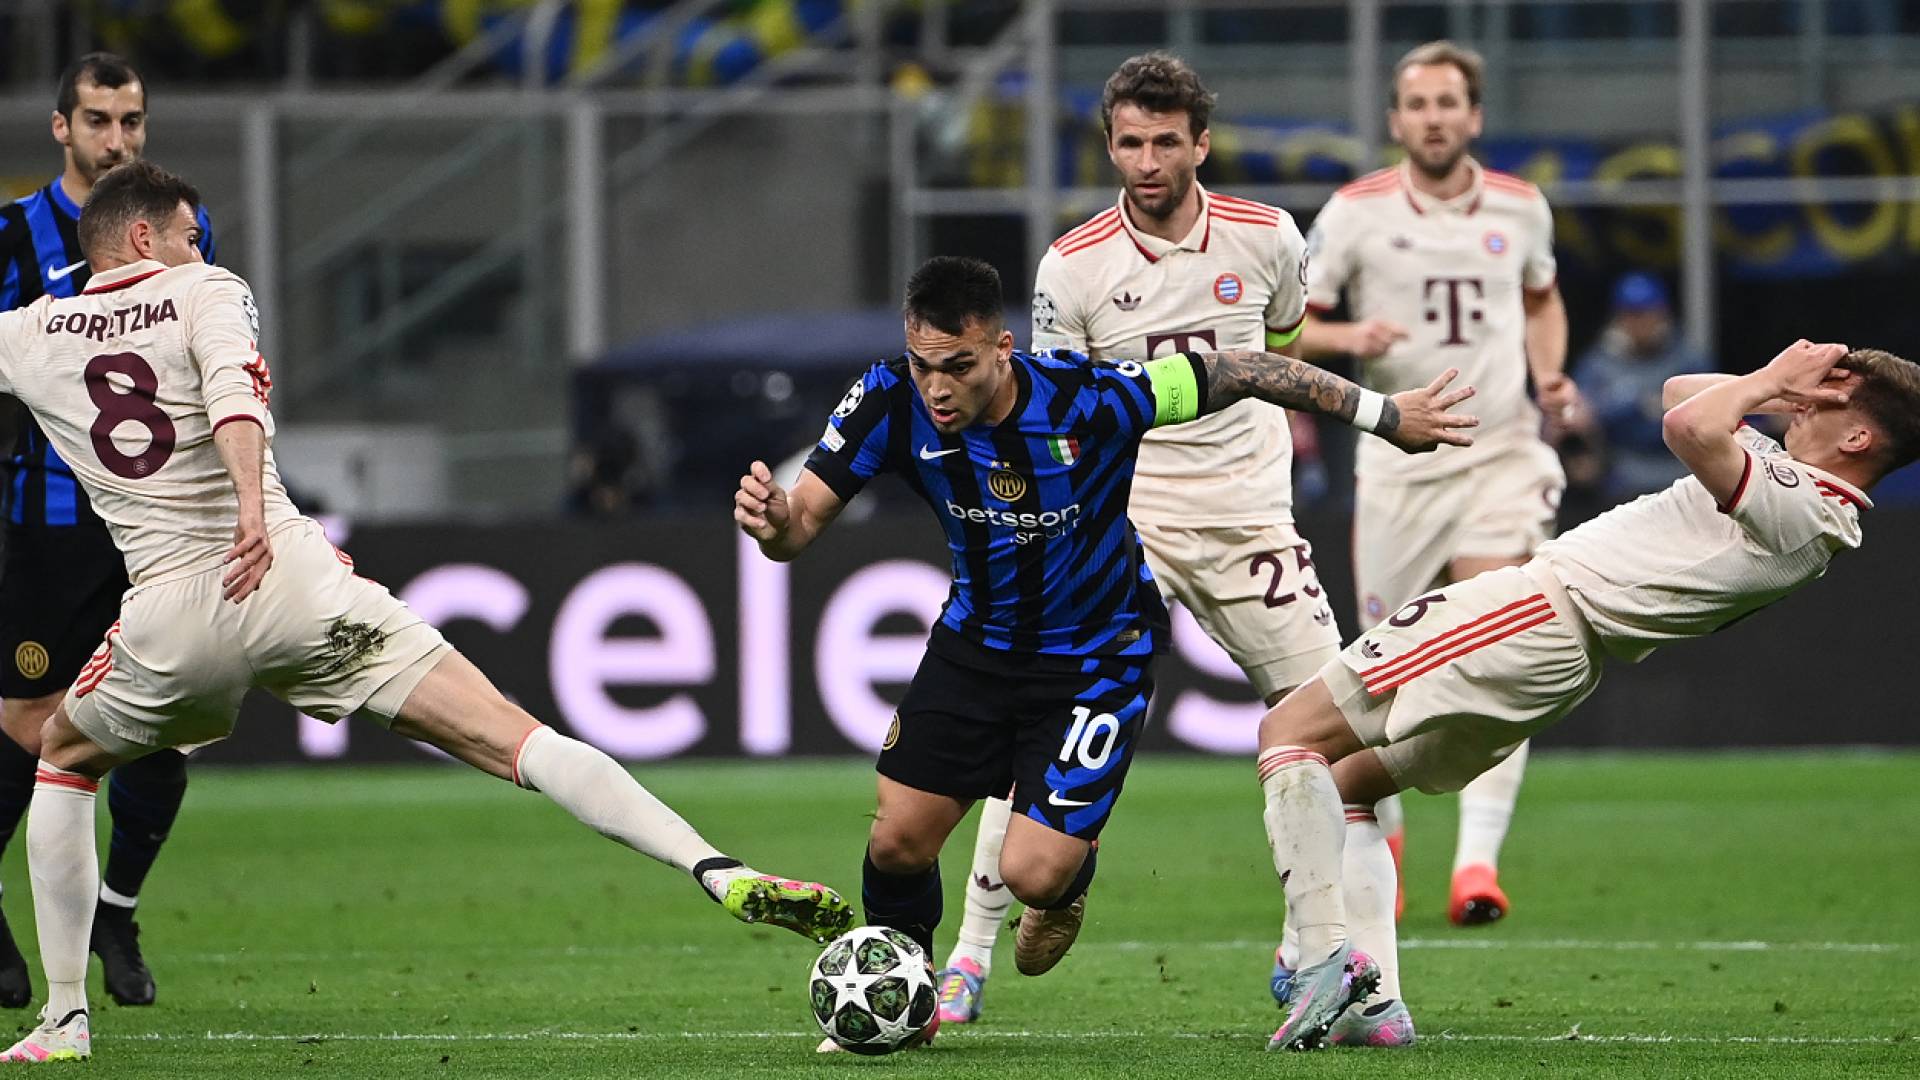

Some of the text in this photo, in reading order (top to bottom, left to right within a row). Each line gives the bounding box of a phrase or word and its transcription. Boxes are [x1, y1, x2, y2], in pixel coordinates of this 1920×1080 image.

[84, 352, 177, 480] 8
[945, 498, 1080, 529] betsson
[1249, 544, 1320, 609] 25
[1389, 593, 1448, 627] 6
[1058, 705, 1120, 770] 10
